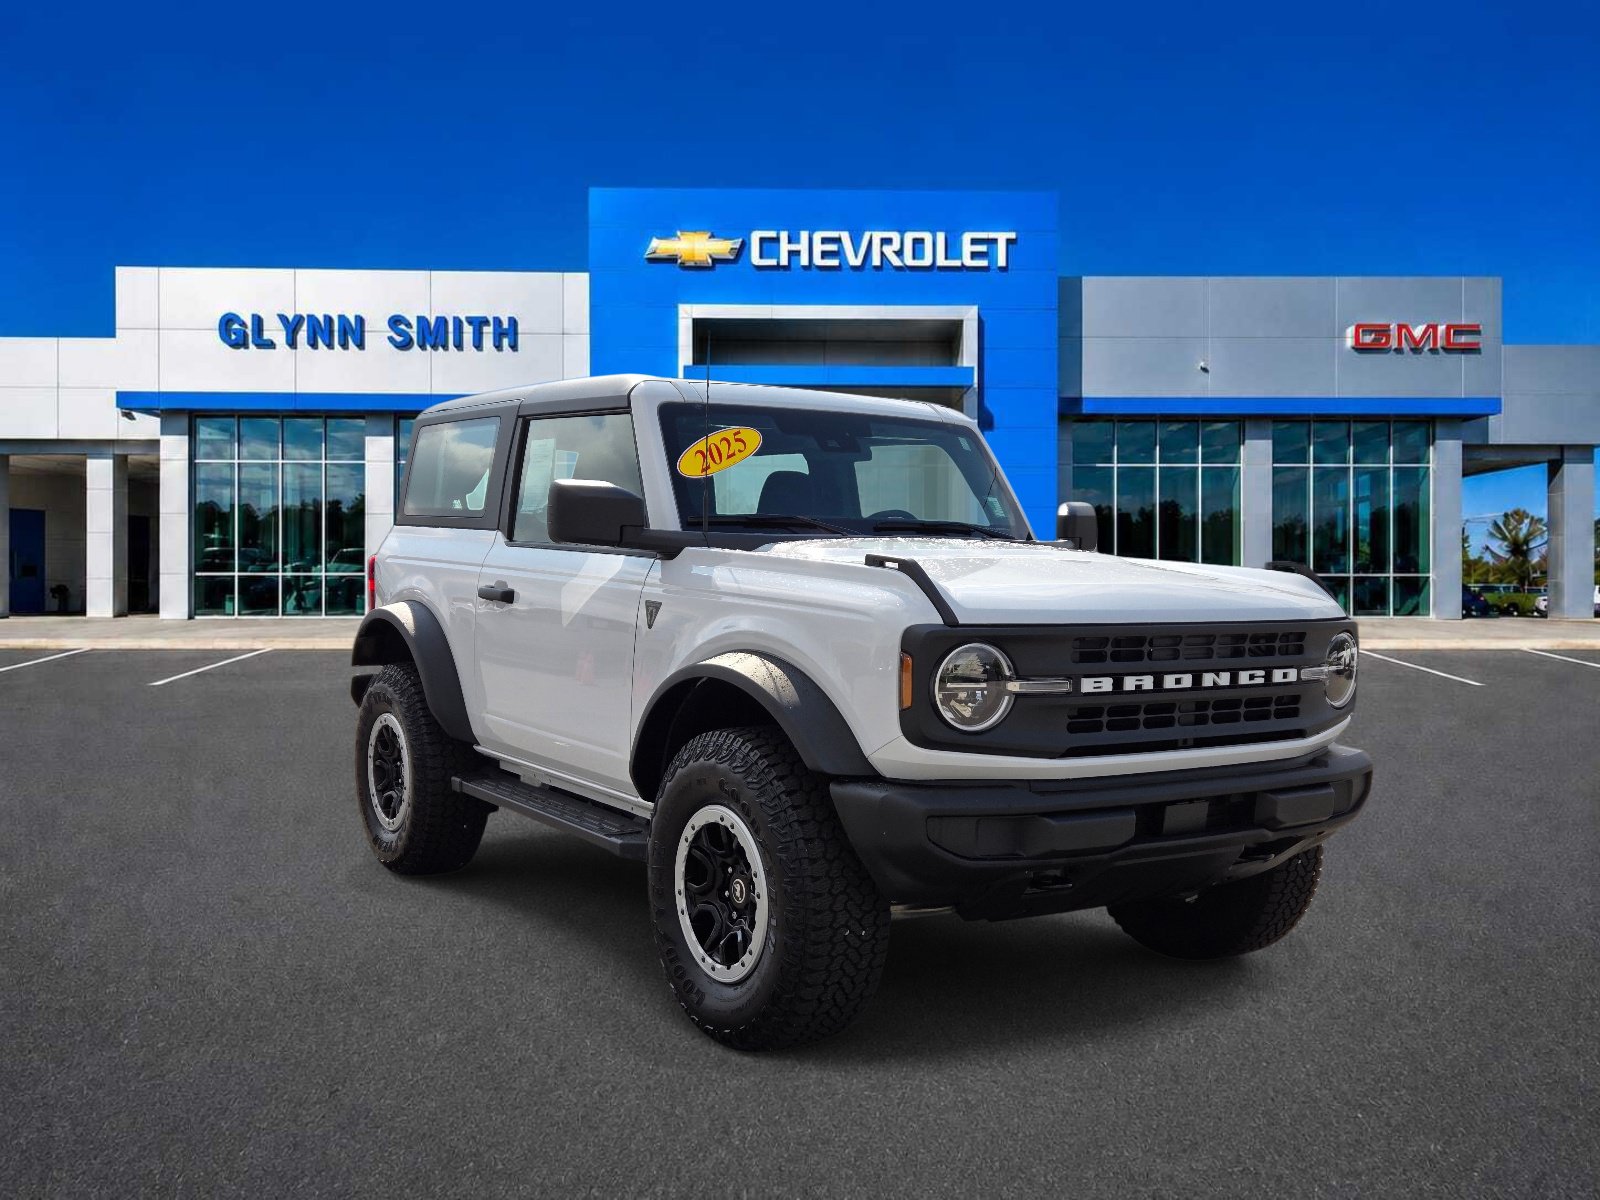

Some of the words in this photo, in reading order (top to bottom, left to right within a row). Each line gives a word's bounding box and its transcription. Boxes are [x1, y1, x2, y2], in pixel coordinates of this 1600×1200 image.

[751, 230, 1017, 269] CHEVROLET
[218, 312, 365, 350] GLYNN
[387, 314, 519, 351] SMITH
[1353, 324, 1482, 351] GMC
[694, 431, 746, 473] 2025
[1081, 668, 1297, 693] BRONCO
